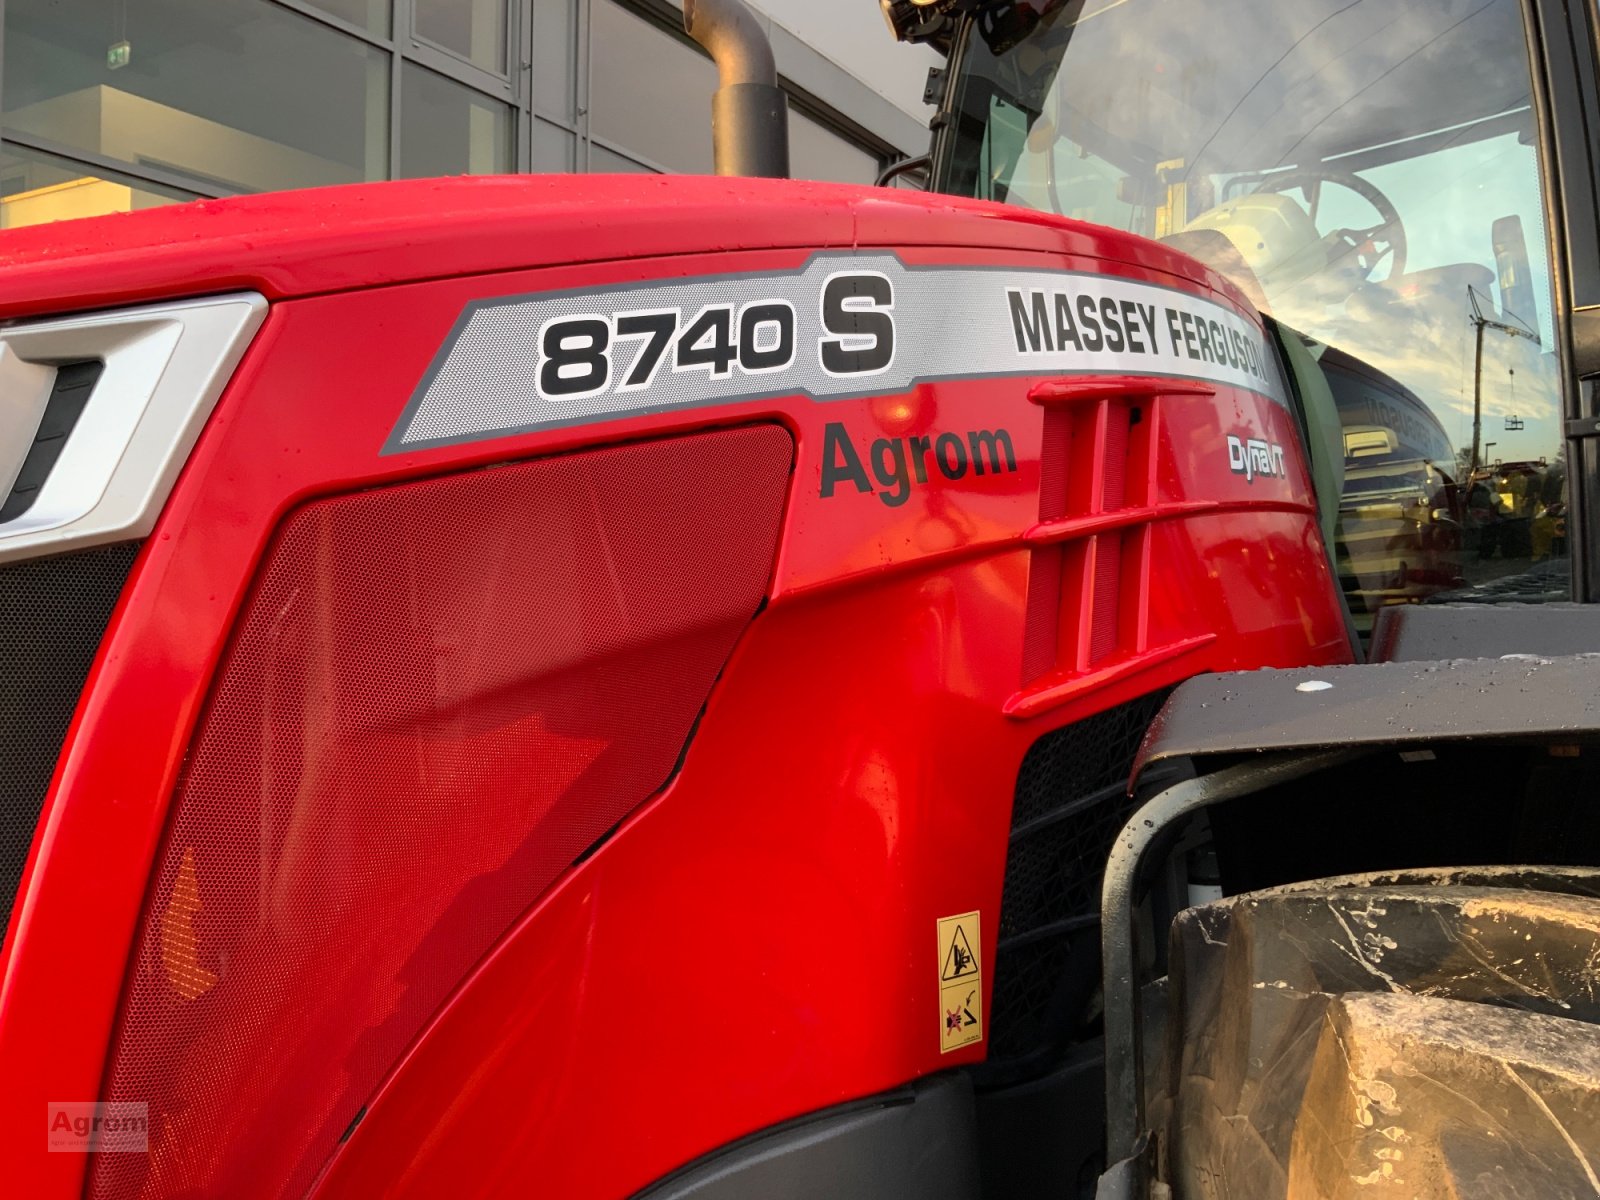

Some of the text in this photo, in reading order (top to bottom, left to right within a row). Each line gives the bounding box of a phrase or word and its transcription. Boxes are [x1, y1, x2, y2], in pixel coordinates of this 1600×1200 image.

[537, 271, 895, 398] 8740 S
[1006, 289, 1268, 382] MASSEY FERGUSON
[820, 422, 1017, 507] Agrom
